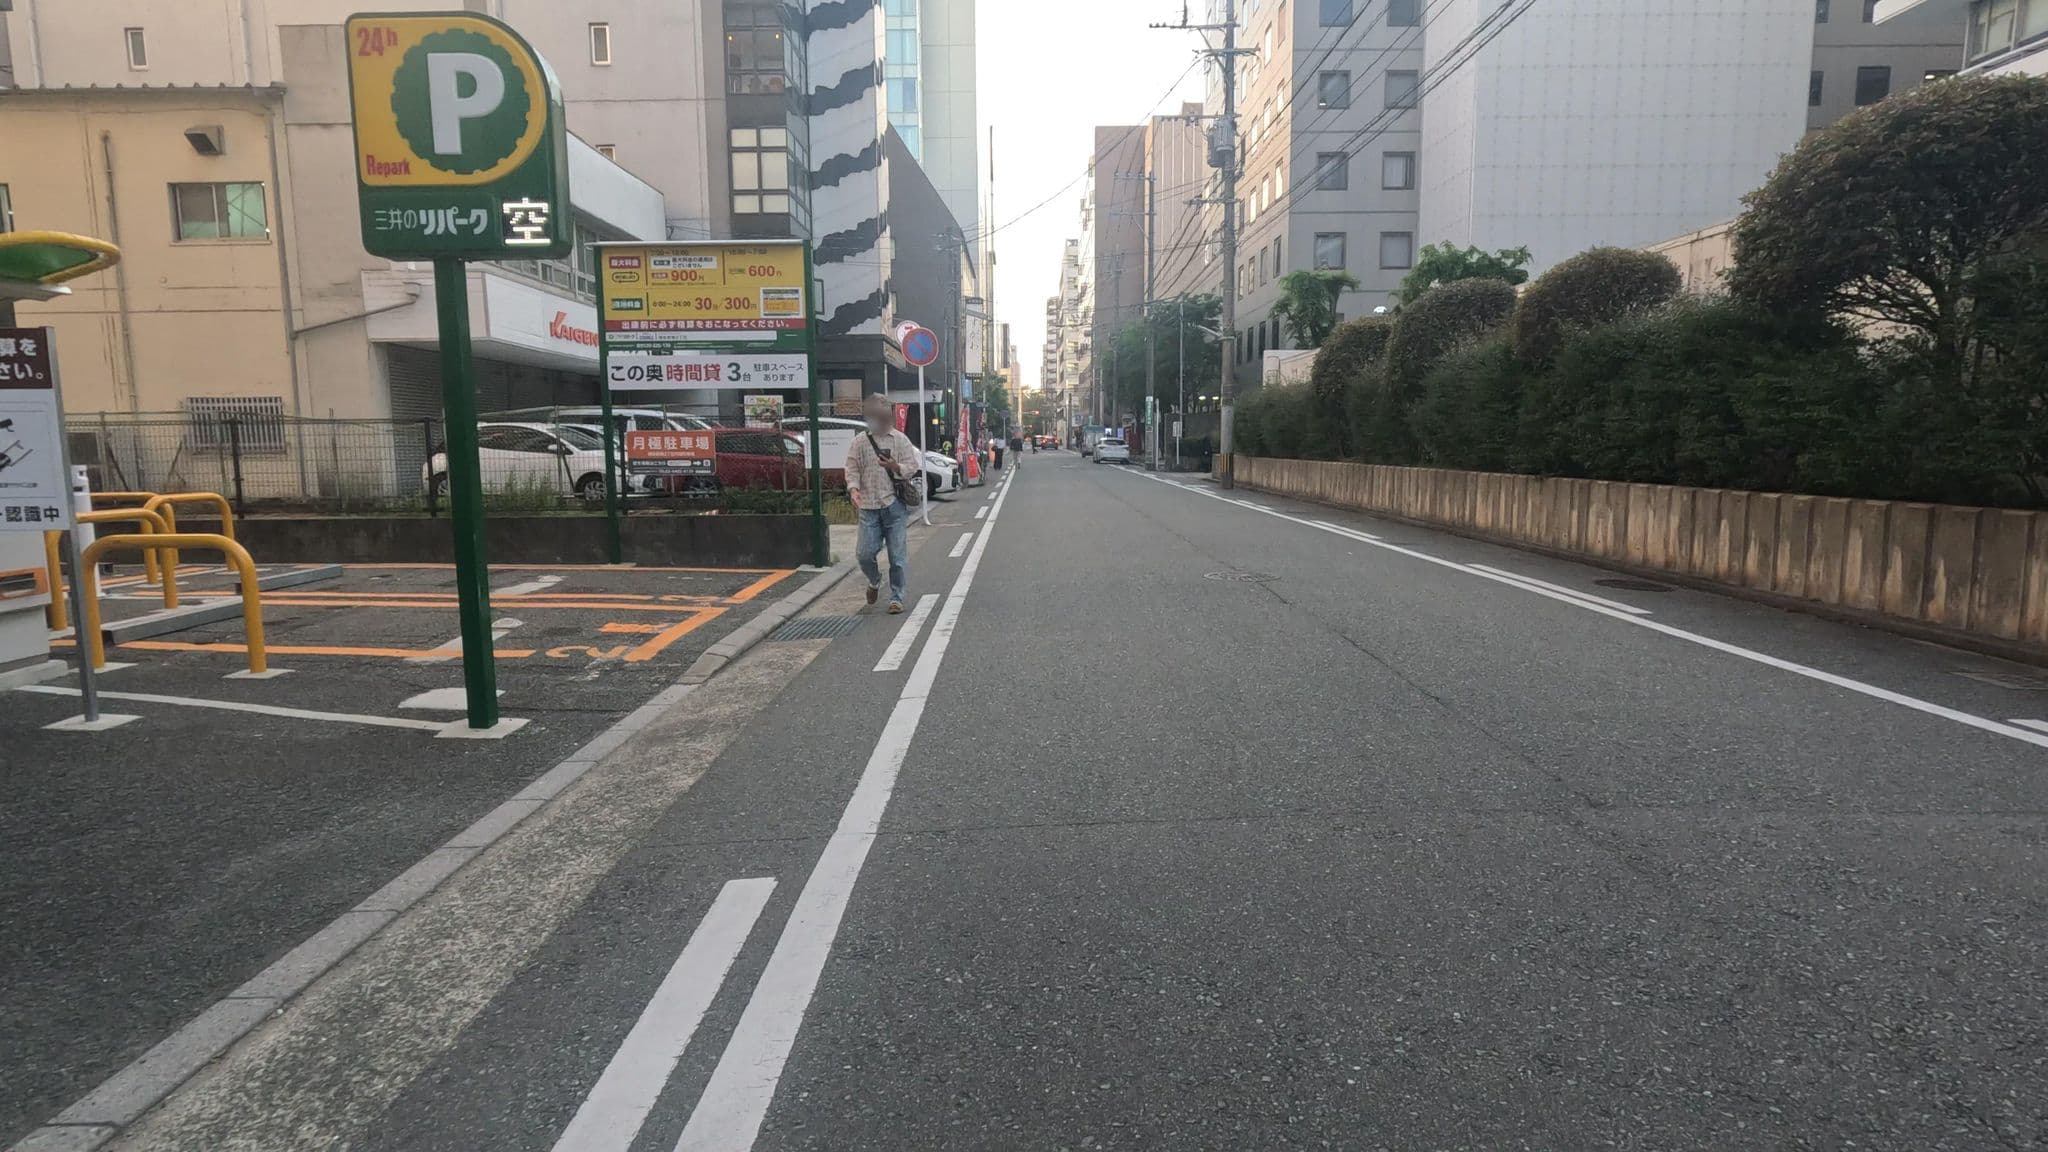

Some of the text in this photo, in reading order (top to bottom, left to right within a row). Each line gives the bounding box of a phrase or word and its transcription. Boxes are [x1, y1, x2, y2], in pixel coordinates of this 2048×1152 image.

[357, 26, 398, 57] 24h
[427, 52, 505, 155] P
[366, 155, 411, 177] Repark
[374, 206, 488, 236] 三井のリパーク
[502, 197, 551, 245] 空
[763, 373, 795, 382] あります
[633, 436, 709, 450] 月極駐車場
[0, 505, 60, 523] 認識中
